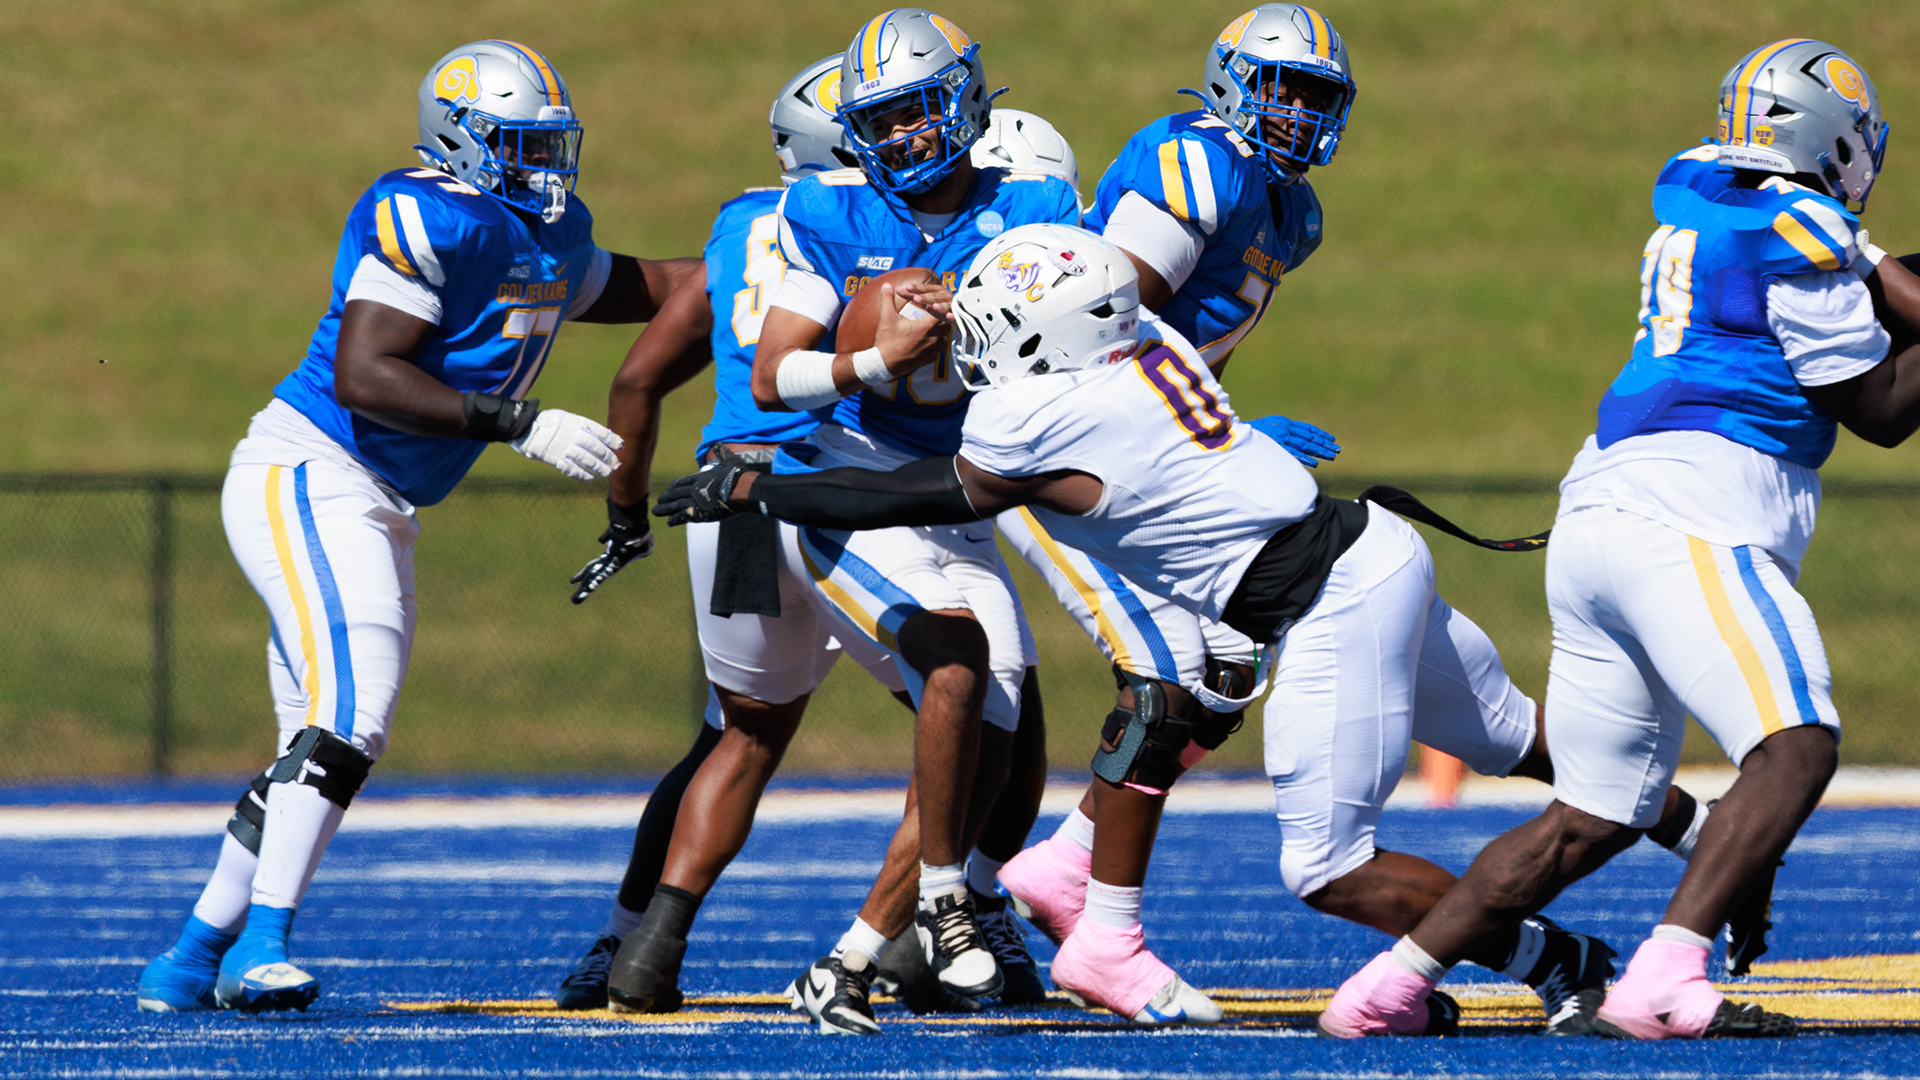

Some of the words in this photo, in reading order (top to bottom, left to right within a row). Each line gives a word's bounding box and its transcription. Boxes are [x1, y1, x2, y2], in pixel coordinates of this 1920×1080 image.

[862, 80, 880, 92] 1903
[856, 255, 894, 270] SIAC
[1132, 337, 1237, 452] 0
